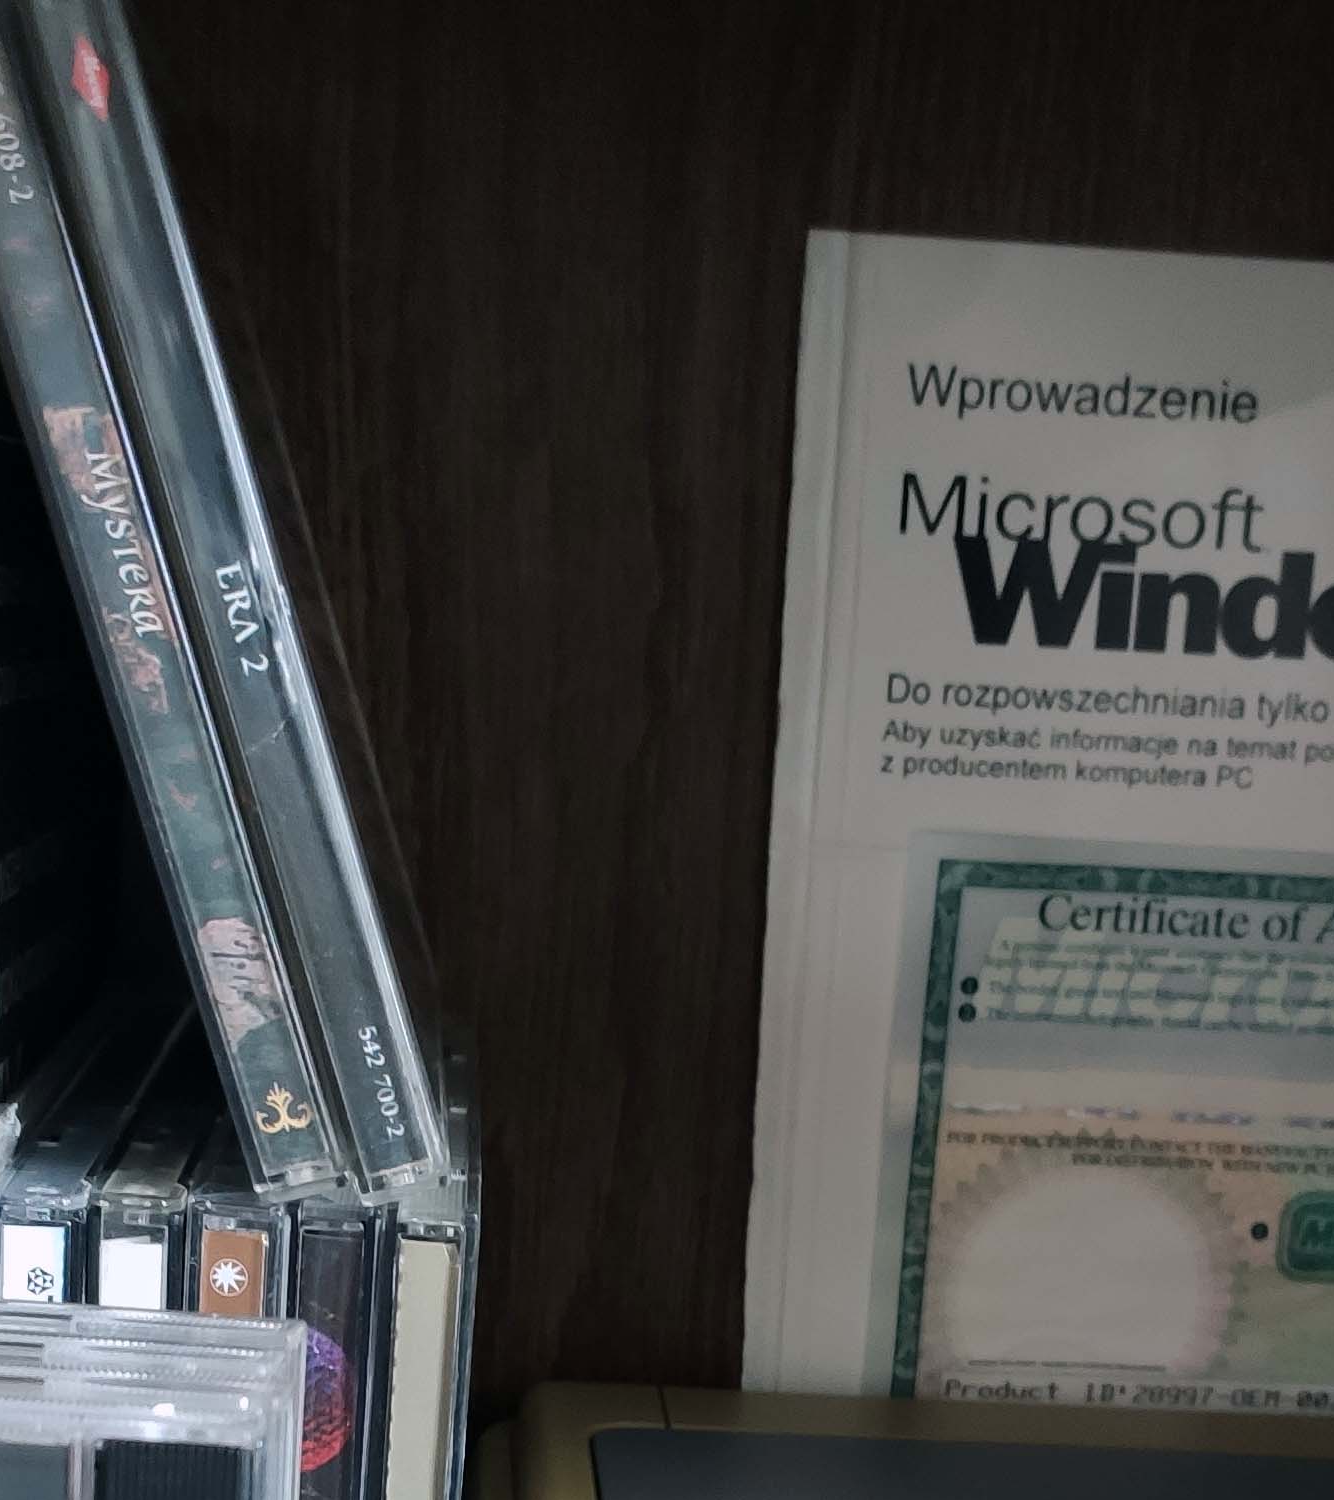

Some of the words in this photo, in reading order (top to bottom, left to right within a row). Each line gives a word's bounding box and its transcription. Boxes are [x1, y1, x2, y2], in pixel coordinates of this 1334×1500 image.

[908, 362, 1259, 422] Wprowadzenie
[899, 471, 1264, 552] Microsoft
[240, 653, 269, 676] 2
[887, 672, 931, 705] Do
[942, 681, 1245, 720] rozpowszechniania
[1257, 692, 1329, 728] tylko
[882, 720, 931, 748] Aby
[940, 724, 1041, 751] uzyskać
[1051, 728, 1179, 759] informacje
[1187, 739, 1217, 757] na
[1227, 738, 1297, 761] temat
[880, 754, 894, 774] z
[903, 754, 1067, 782] producentem
[1075, 761, 1207, 789] komputera
[1216, 765, 1254, 790] PC
[1038, 893, 1250, 943] Certificate
[1263, 909, 1306, 946] of
[358, 1026, 385, 1069] 542
[374, 1073, 405, 1142] 700-2
[944, 1377, 1059, 1402] Product
